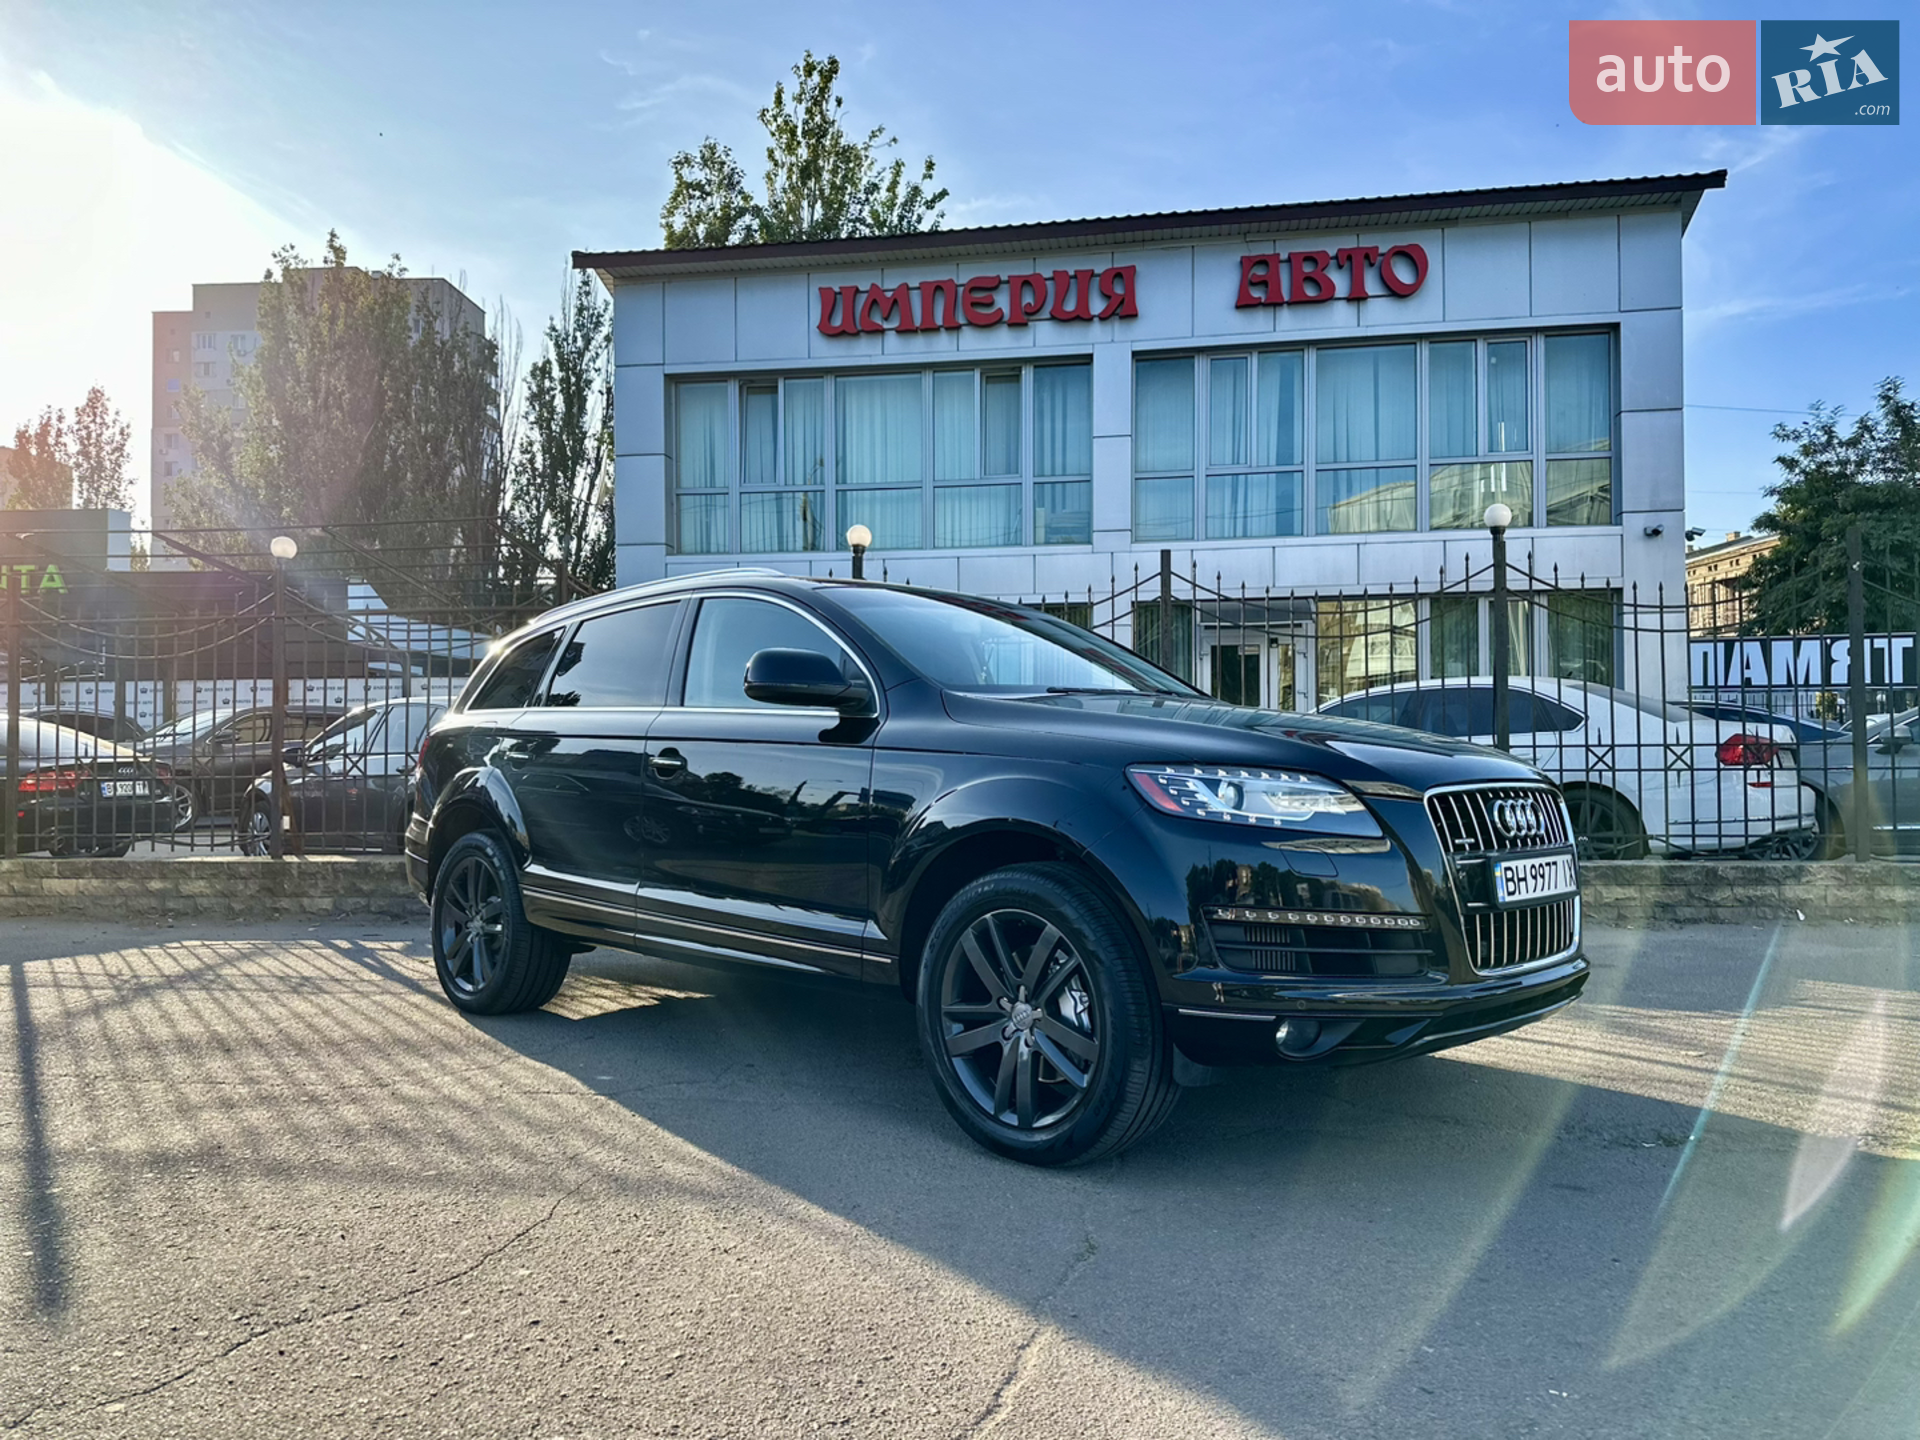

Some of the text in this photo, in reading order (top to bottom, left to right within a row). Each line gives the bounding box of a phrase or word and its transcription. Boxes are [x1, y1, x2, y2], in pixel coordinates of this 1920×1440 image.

[816, 242, 1429, 337] ИМПЕРИЯ АВТО
[1503, 863, 1529, 897] BH
[1529, 860, 1558, 893] 9977
